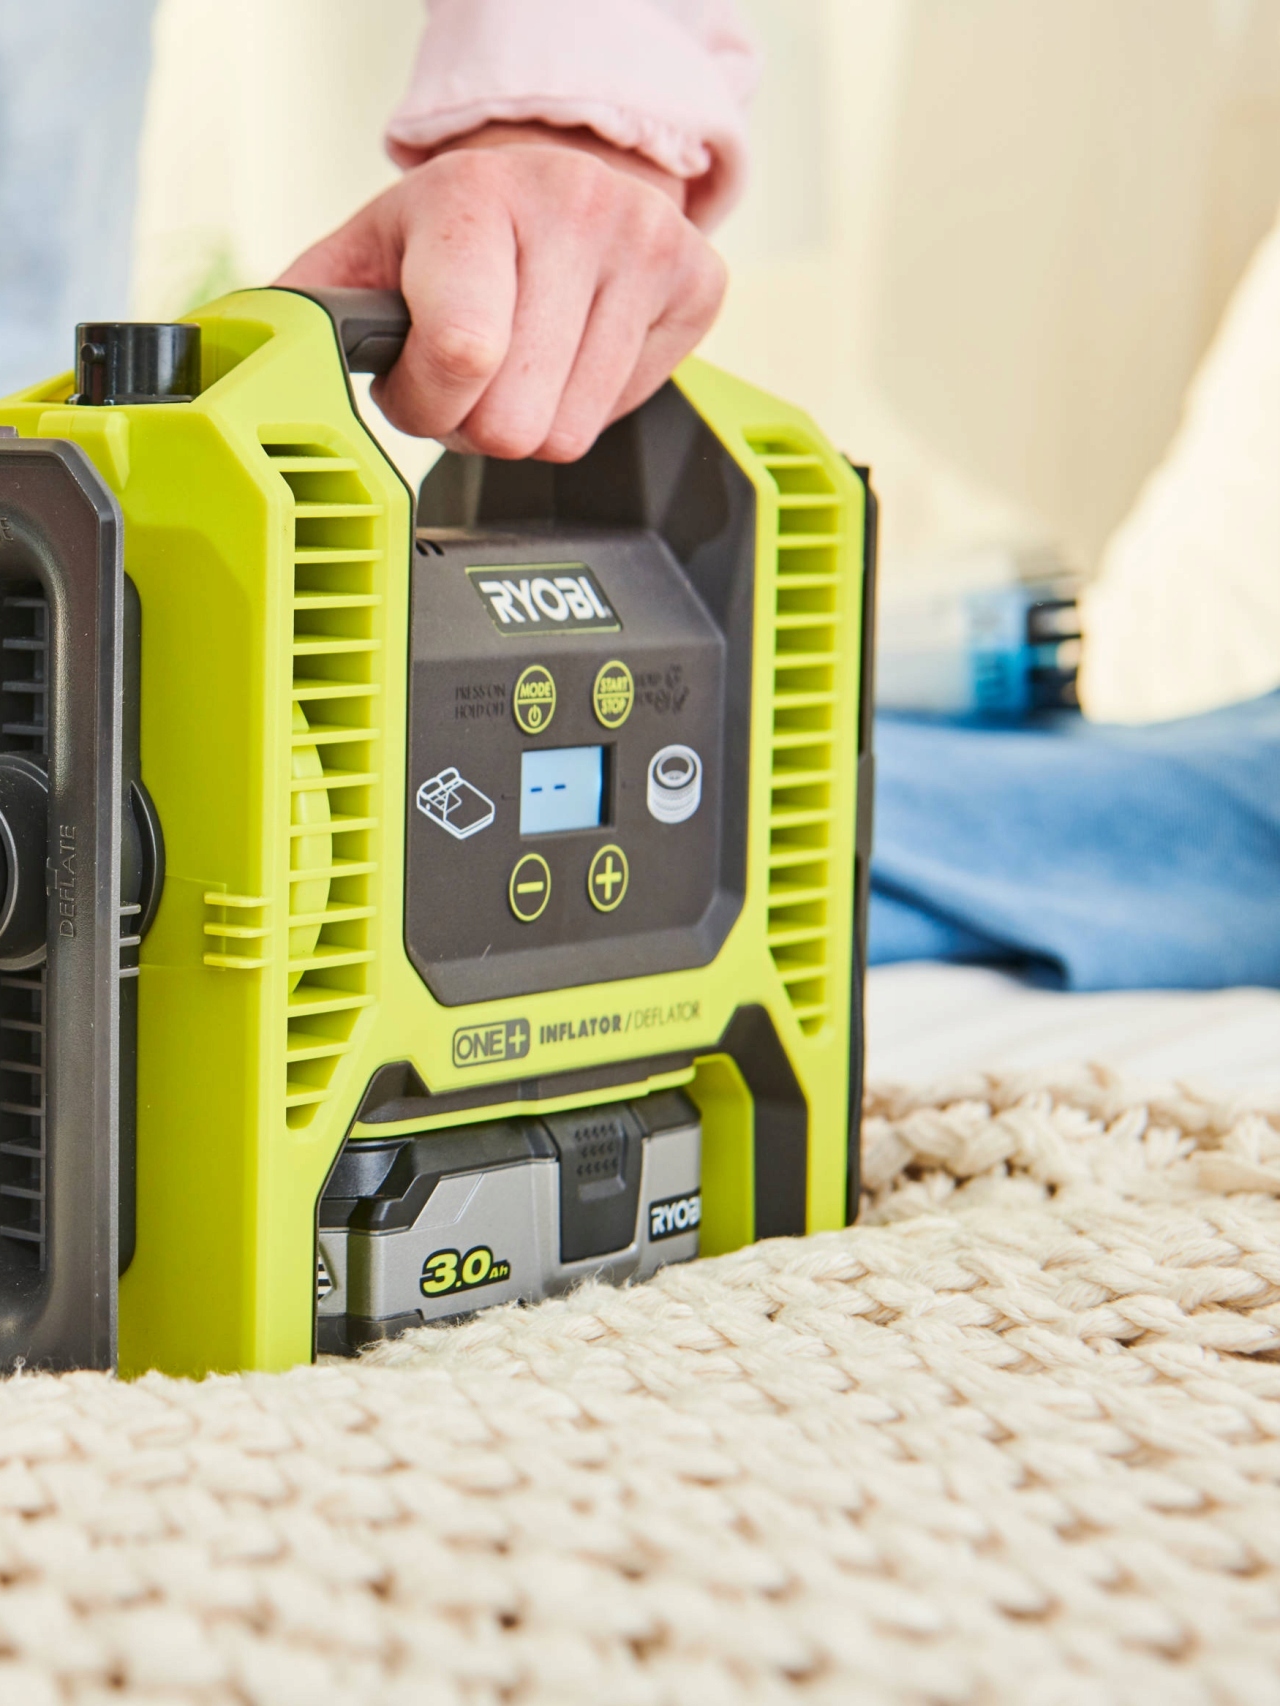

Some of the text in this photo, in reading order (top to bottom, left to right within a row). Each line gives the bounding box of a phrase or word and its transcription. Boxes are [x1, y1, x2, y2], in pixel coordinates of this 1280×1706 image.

[478, 576, 607, 624] RYOBI
[520, 681, 552, 698] MODE
[600, 676, 628, 693] START
[601, 698, 626, 715] STOP
[59, 824, 77, 938] DEFLATE
[651, 1195, 701, 1236] RYOB
